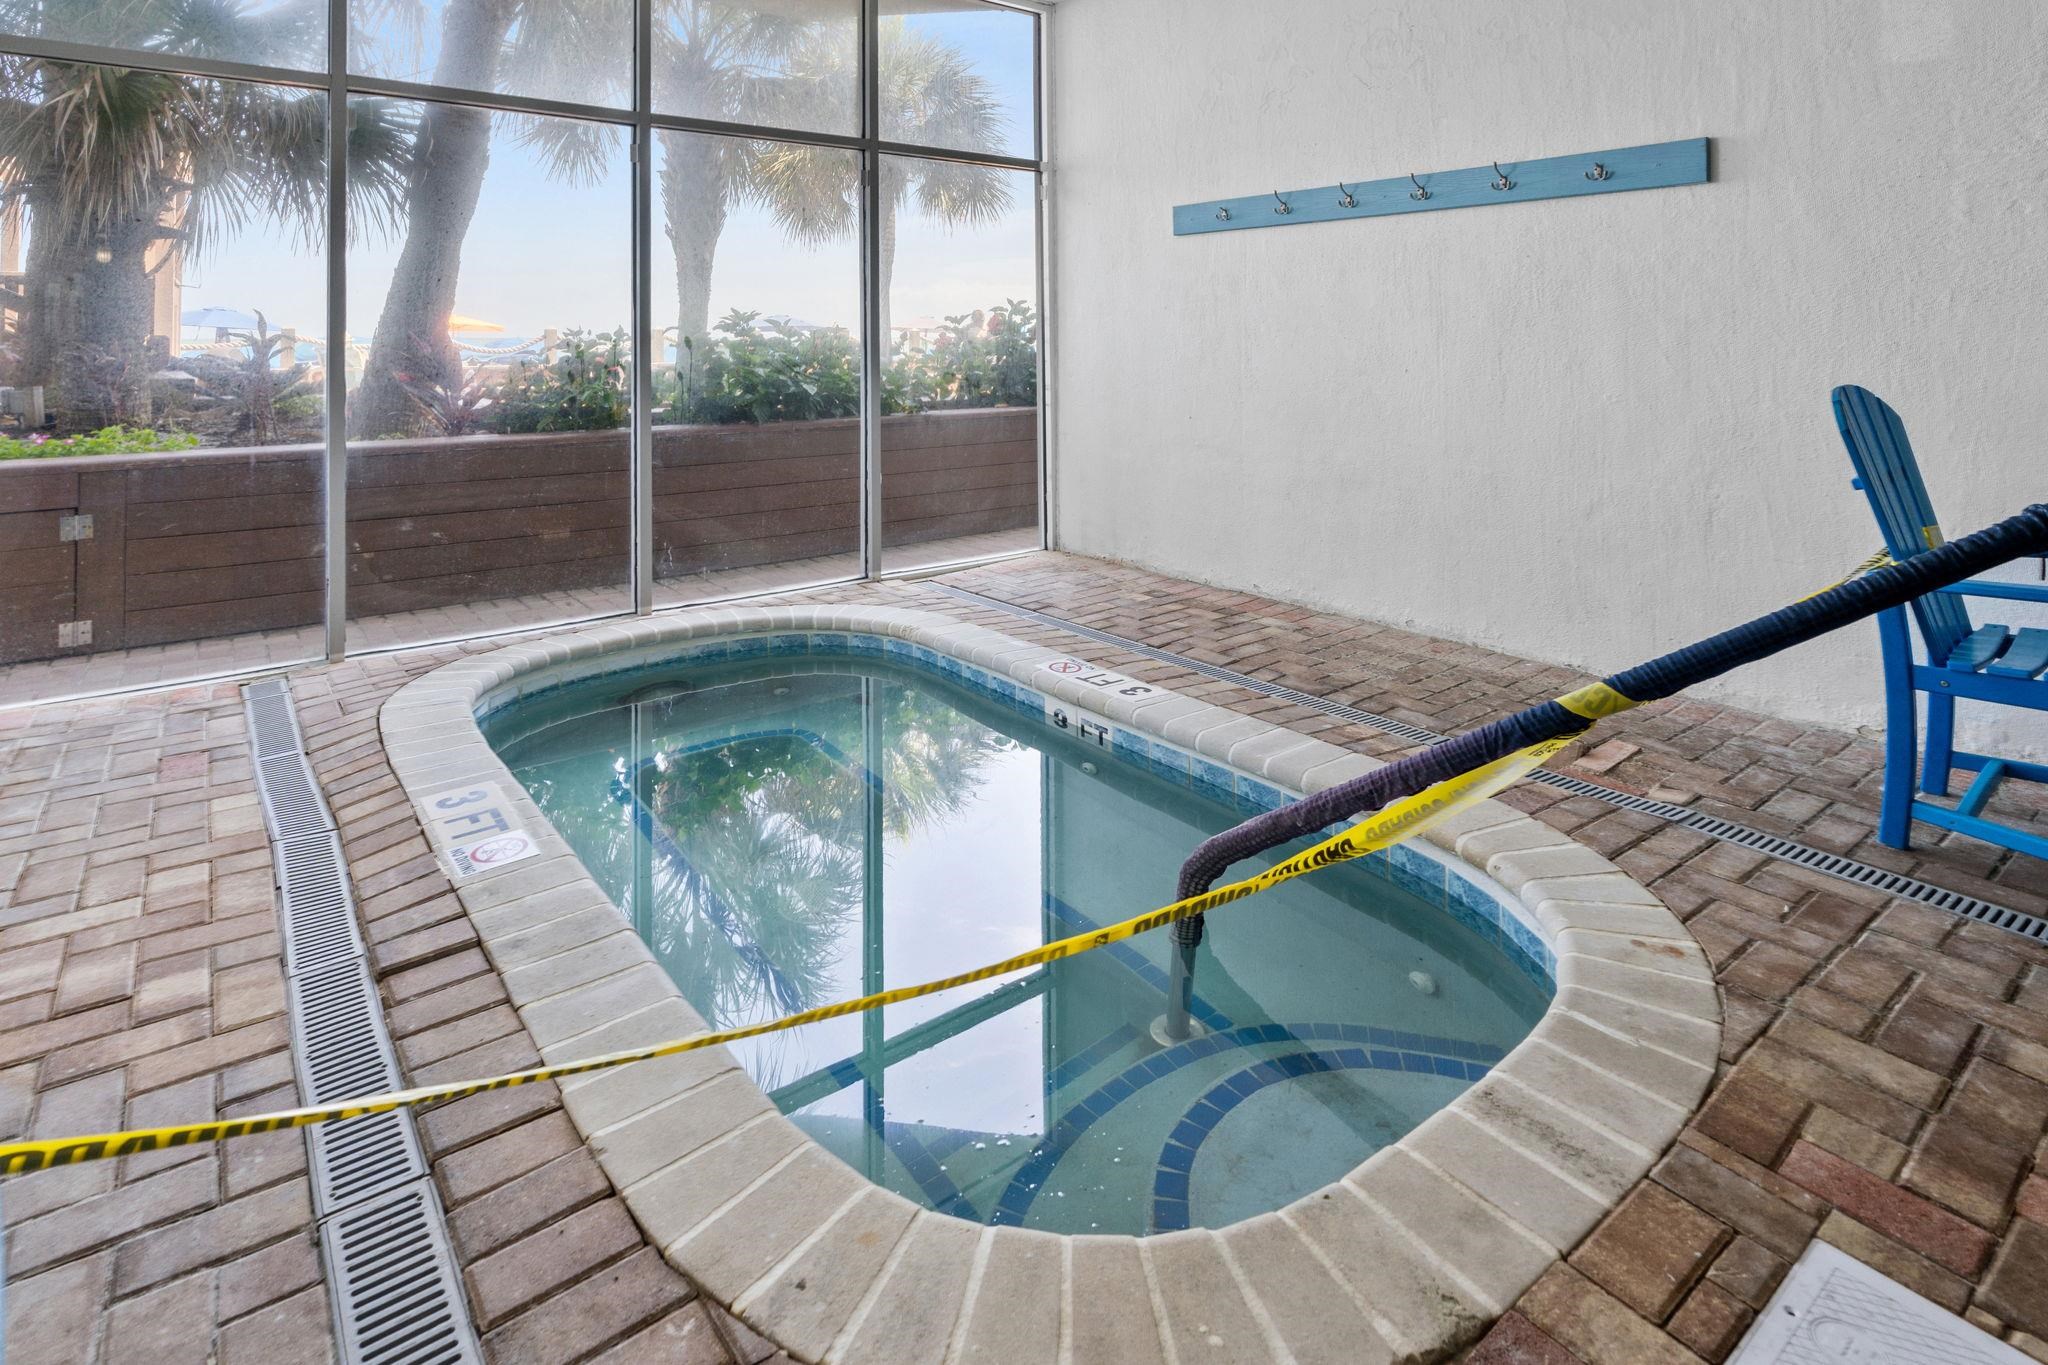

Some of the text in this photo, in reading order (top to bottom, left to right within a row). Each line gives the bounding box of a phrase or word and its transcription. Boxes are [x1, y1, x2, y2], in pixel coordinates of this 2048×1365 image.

[1075, 673, 1152, 696] 3 FT
[1080, 718, 1109, 746] FT
[435, 790, 509, 840] 3 FT
